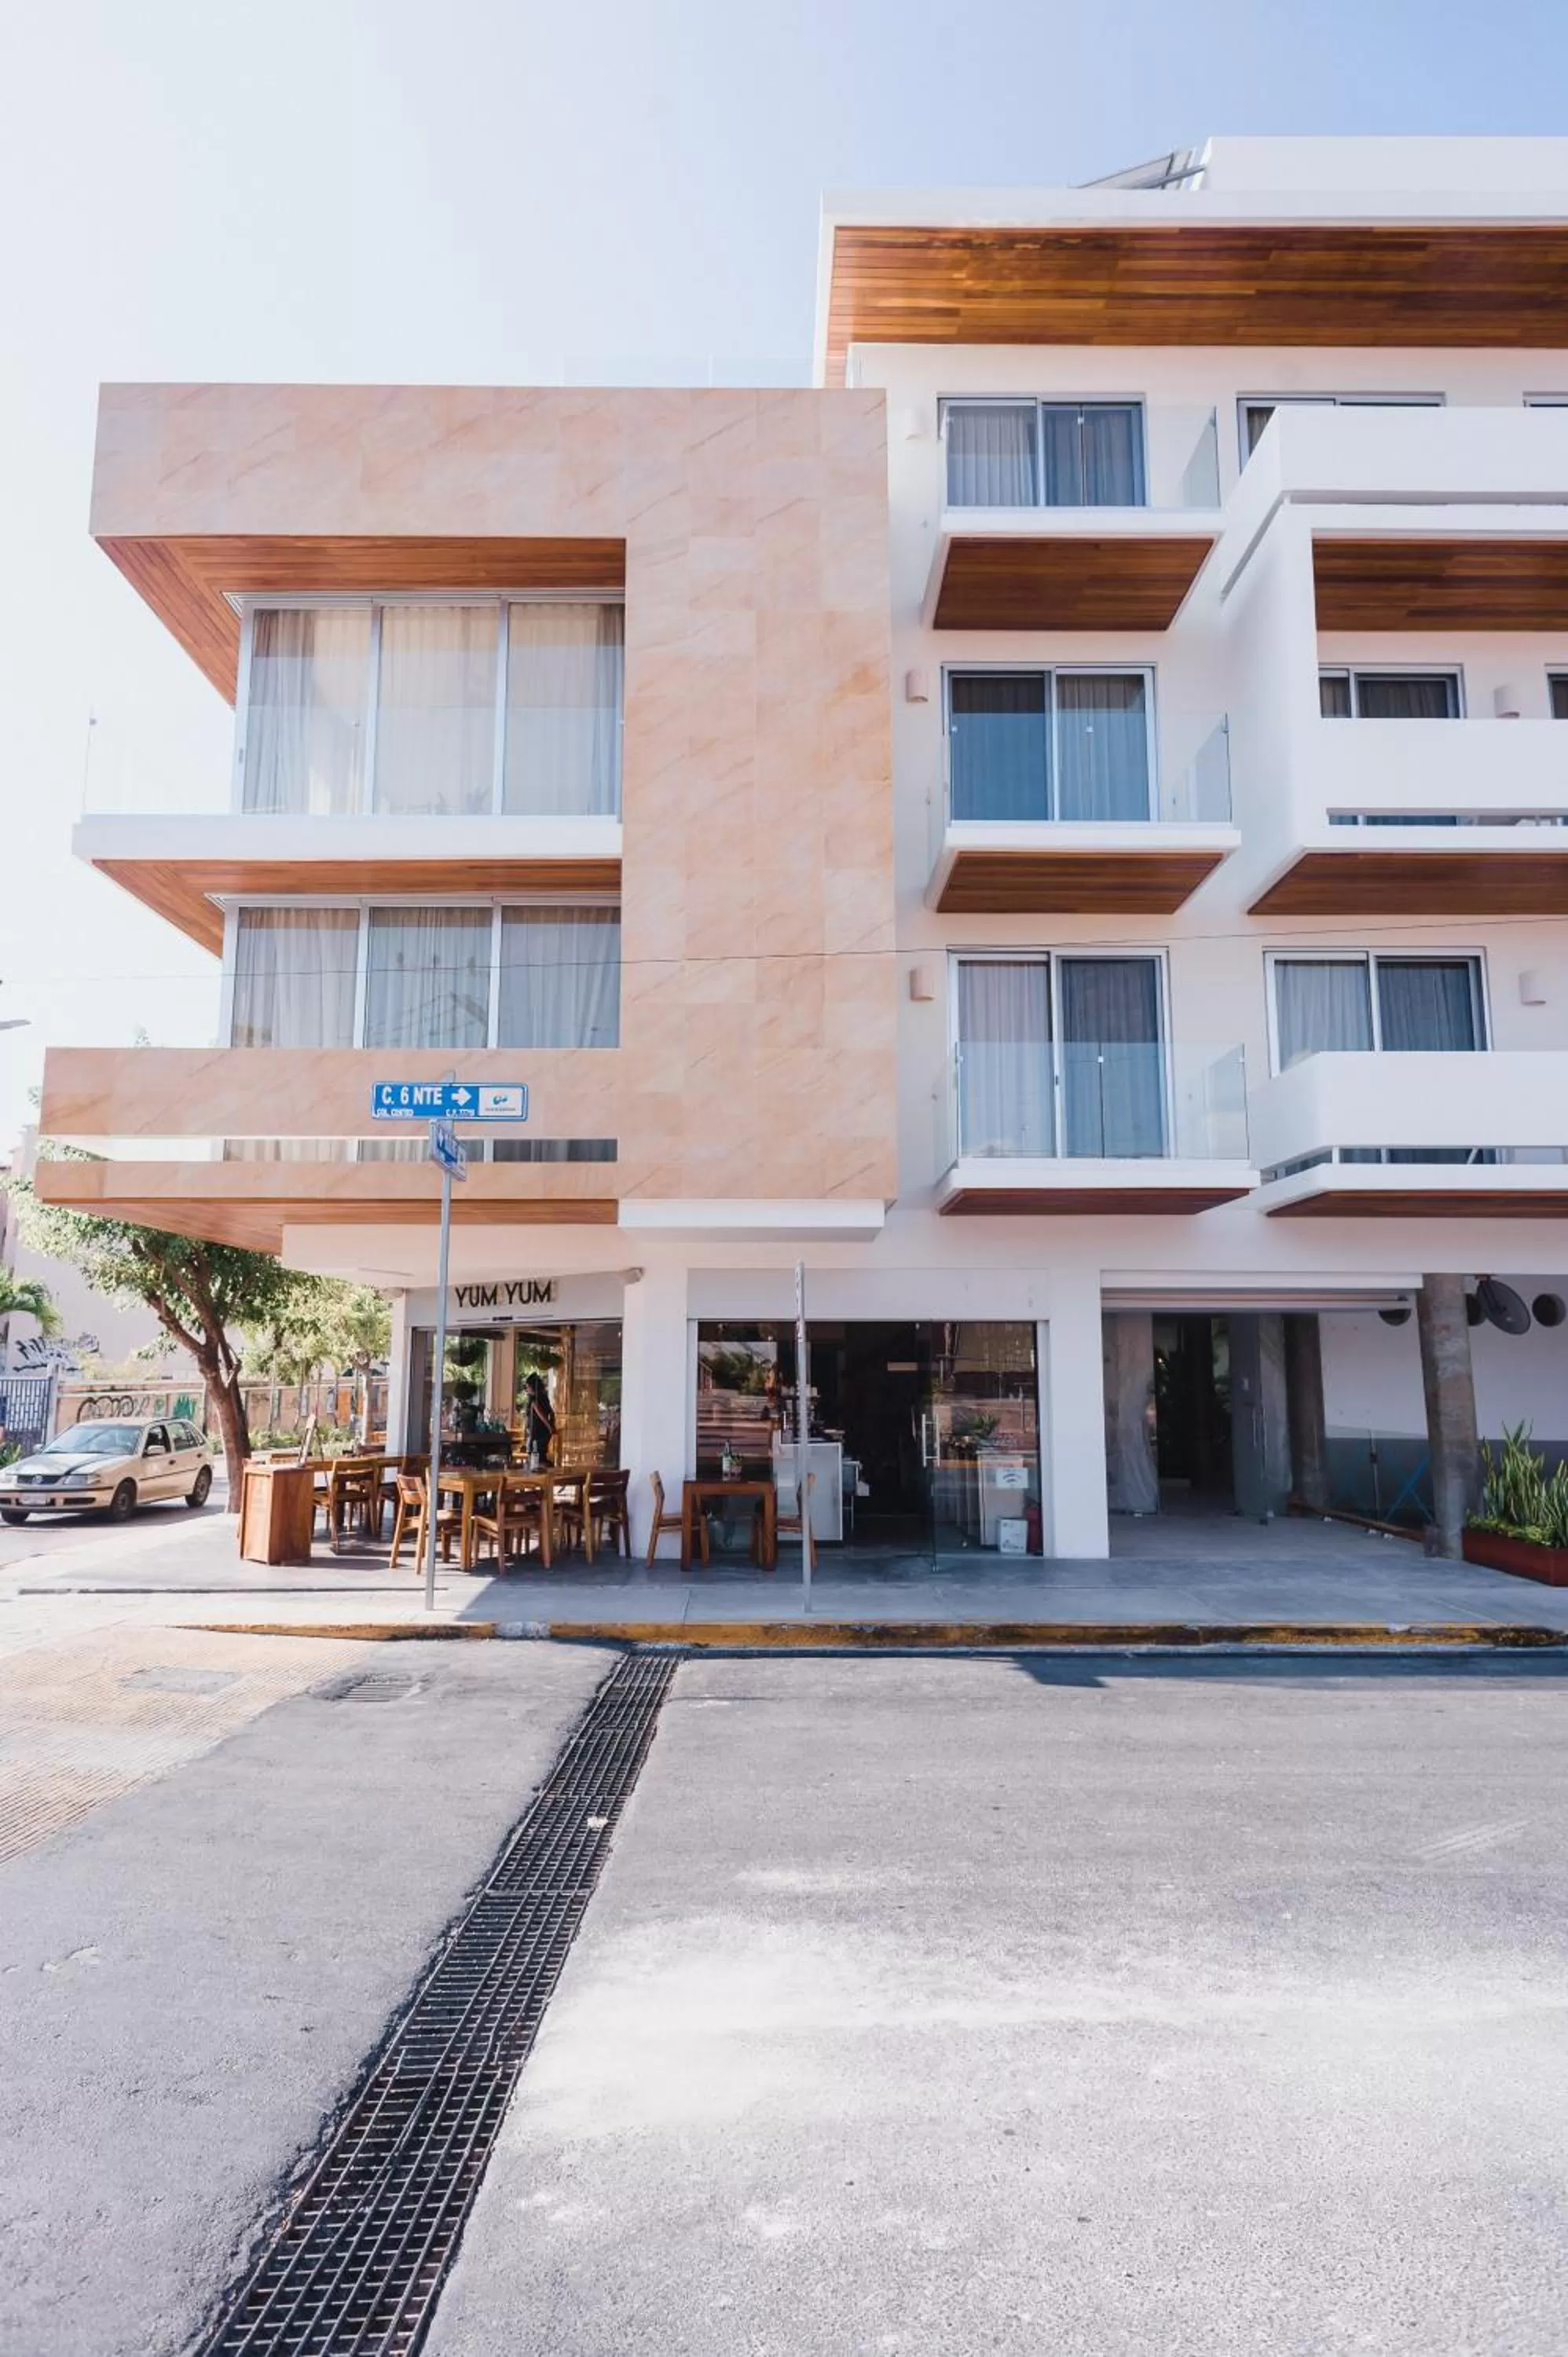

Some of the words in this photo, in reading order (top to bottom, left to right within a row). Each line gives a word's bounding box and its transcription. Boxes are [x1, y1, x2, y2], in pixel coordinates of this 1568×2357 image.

[383, 1087, 394, 1105] C.
[401, 1087, 409, 1105] 6
[412, 1087, 442, 1105] NTE
[456, 1285, 497, 1307] YUM
[504, 1280, 551, 1305] YUM
